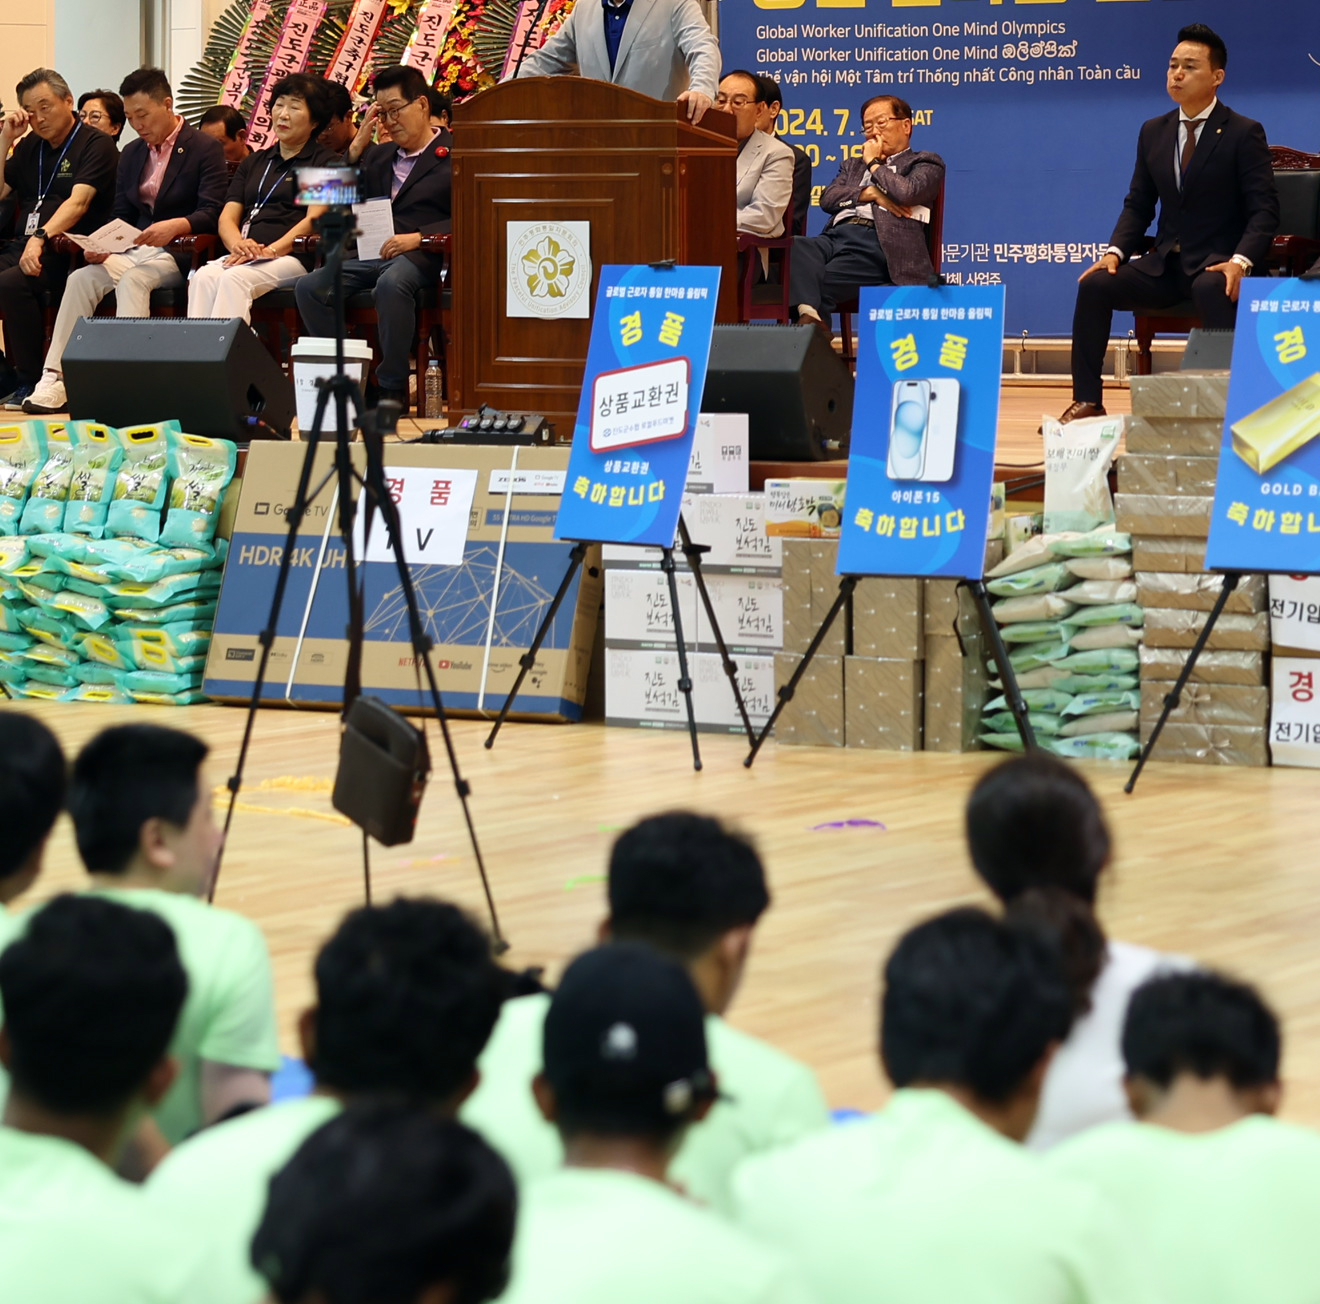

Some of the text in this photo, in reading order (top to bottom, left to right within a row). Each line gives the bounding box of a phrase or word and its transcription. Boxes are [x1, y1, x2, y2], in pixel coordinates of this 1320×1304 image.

[411, 13, 442, 67] 진도군
[756, 20, 1066, 39] Global Worker Unification One Mind Olympics
[756, 48, 797, 63] Global
[801, 48, 851, 61] Worker
[854, 46, 929, 61] Unification
[932, 46, 960, 60] One
[964, 45, 998, 60] Mind
[784, 70, 809, 87] vận
[811, 69, 832, 87] hội
[835, 69, 862, 87] Một
[865, 69, 894, 84] Tâm
[897, 67, 915, 83] trí
[917, 67, 960, 86] Thống
[964, 67, 995, 83] nhất
[999, 67, 1035, 85] Công
[1039, 66, 1074, 81] nhân
[1077, 64, 1111, 80] Toàn
[1115, 64, 1141, 80] cầu
[775, 108, 828, 136] 024.
[599, 381, 679, 419] 상품교환권
[604, 460, 650, 475] 상품교환권
[572, 476, 665, 507] 축하합니다
[891, 489, 940, 503] 아이폰 15
[1261, 482, 1303, 496] GOLD
[854, 507, 966, 539] 축하합니다
[238, 545, 281, 567] HDR
